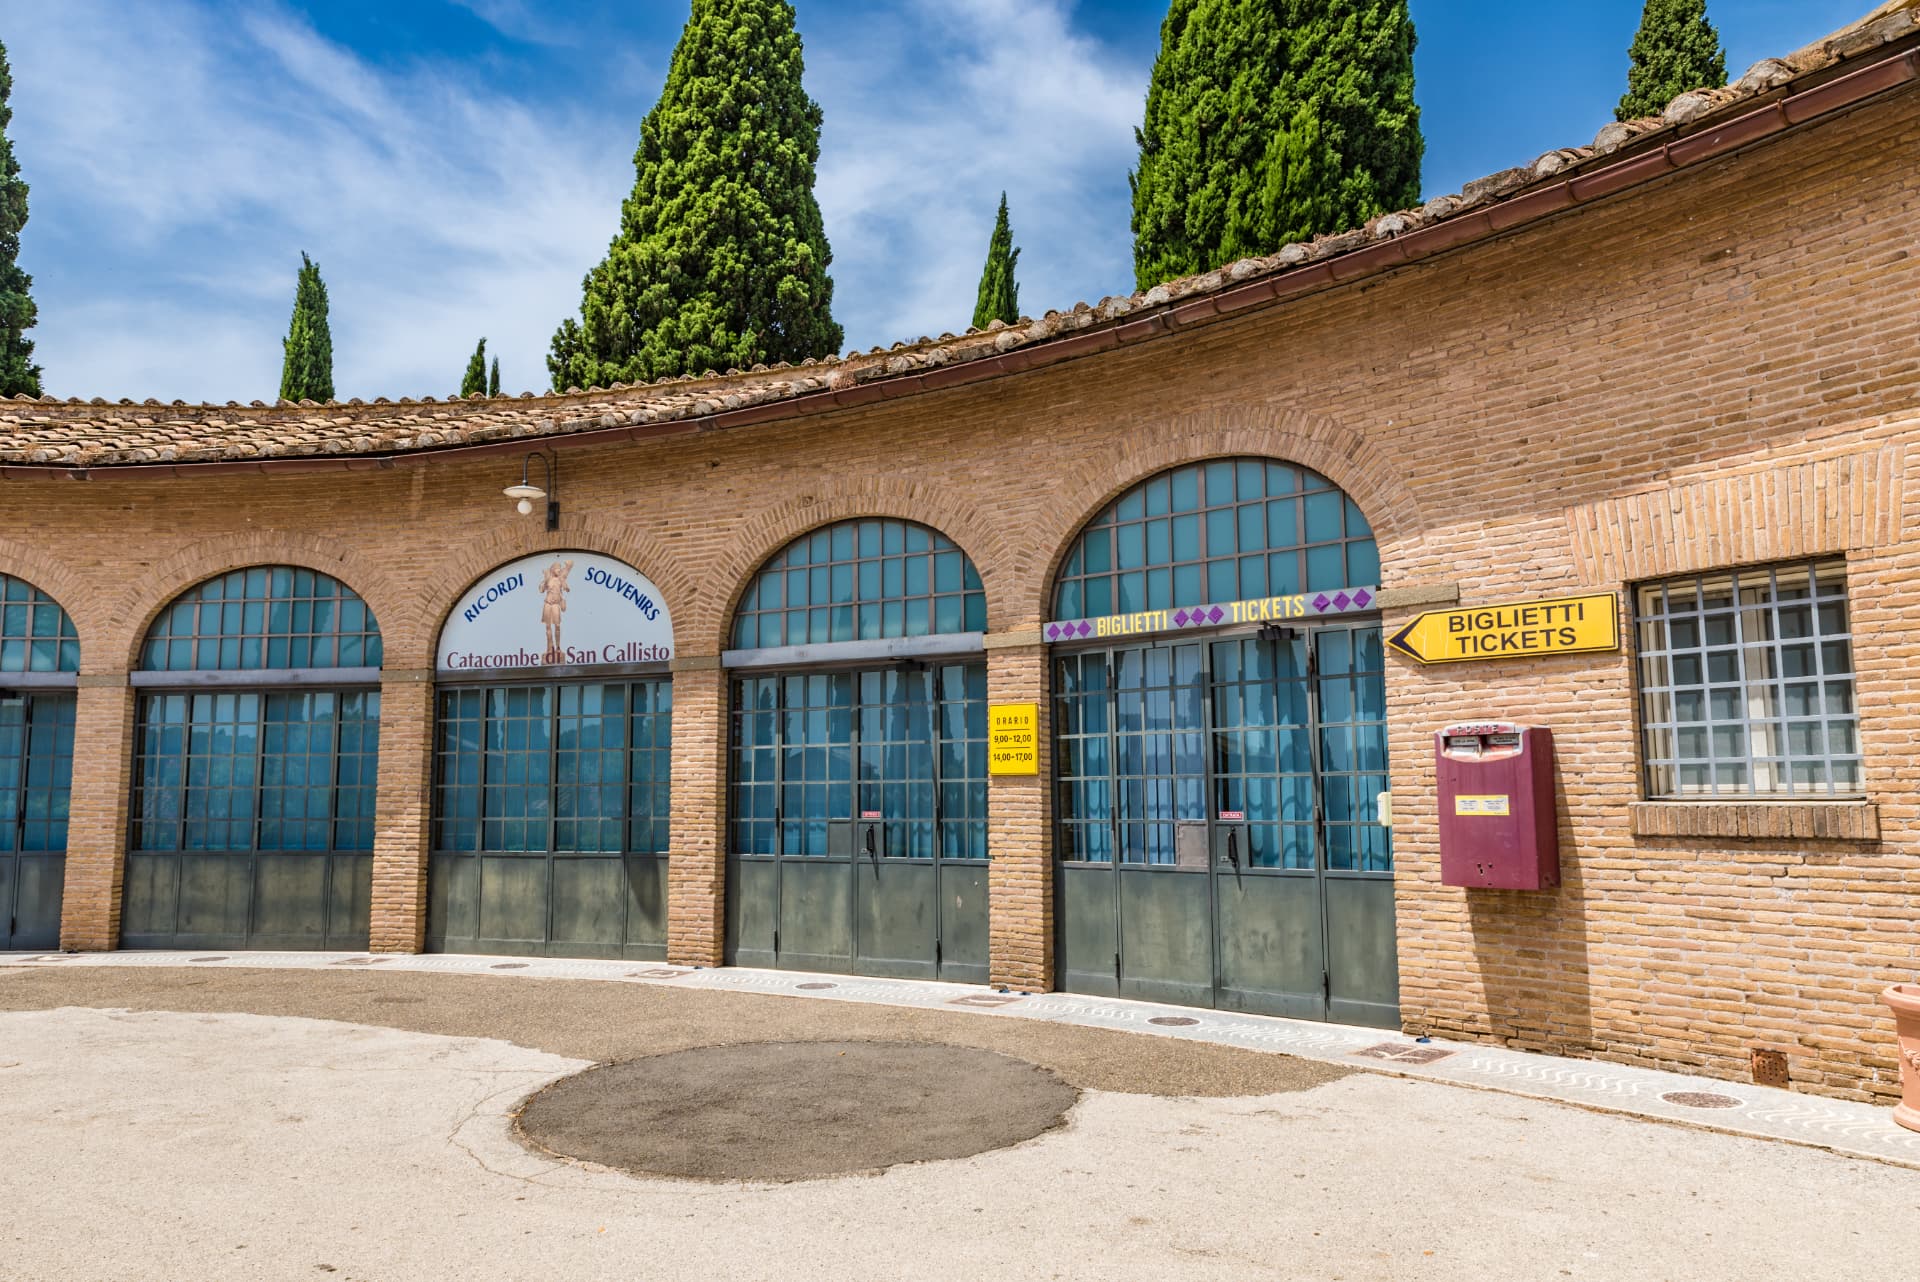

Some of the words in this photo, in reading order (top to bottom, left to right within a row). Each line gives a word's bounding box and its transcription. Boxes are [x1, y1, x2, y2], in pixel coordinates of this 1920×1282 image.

[464, 573, 524, 623] RICORDI
[584, 566, 661, 622] SOUVENIRS
[1097, 609, 1168, 637] BIGLIETTI
[1230, 594, 1305, 624] TICKETS
[1448, 602, 1584, 634] BIGLIETTI
[1455, 627, 1577, 654] TICKETS
[447, 647, 539, 669] Catacombe
[545, 648, 561, 665] di
[566, 646, 597, 664] San
[602, 642, 670, 664] Callisto
[996, 716, 1029, 725] ORARIO
[1456, 724, 1499, 734] POSTE
